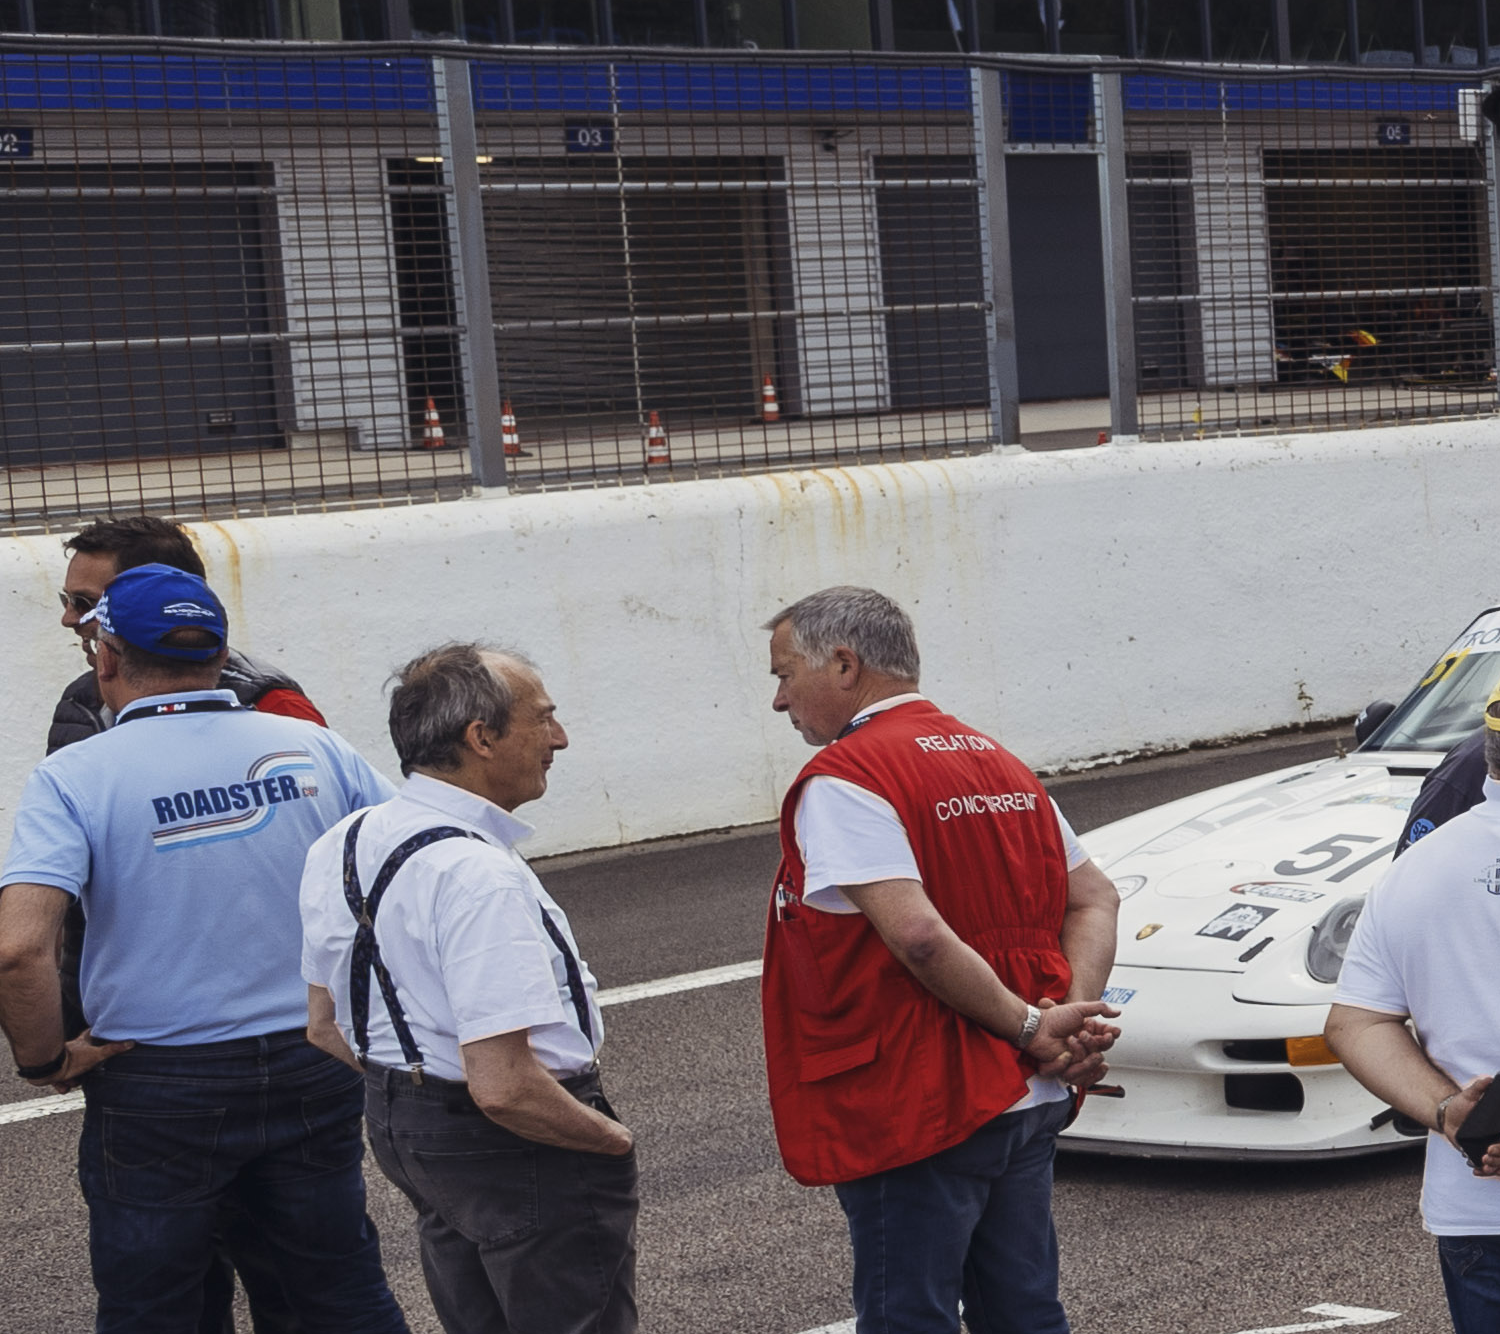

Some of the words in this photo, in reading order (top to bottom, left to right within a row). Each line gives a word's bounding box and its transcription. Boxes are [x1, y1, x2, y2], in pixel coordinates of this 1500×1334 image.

[578, 129, 603, 147] 03
[914, 733, 996, 753] RELATION
[151, 774, 301, 825] ROADSTER
[935, 792, 1038, 821] CONCURRENT
[1273, 833, 1400, 884] 51
